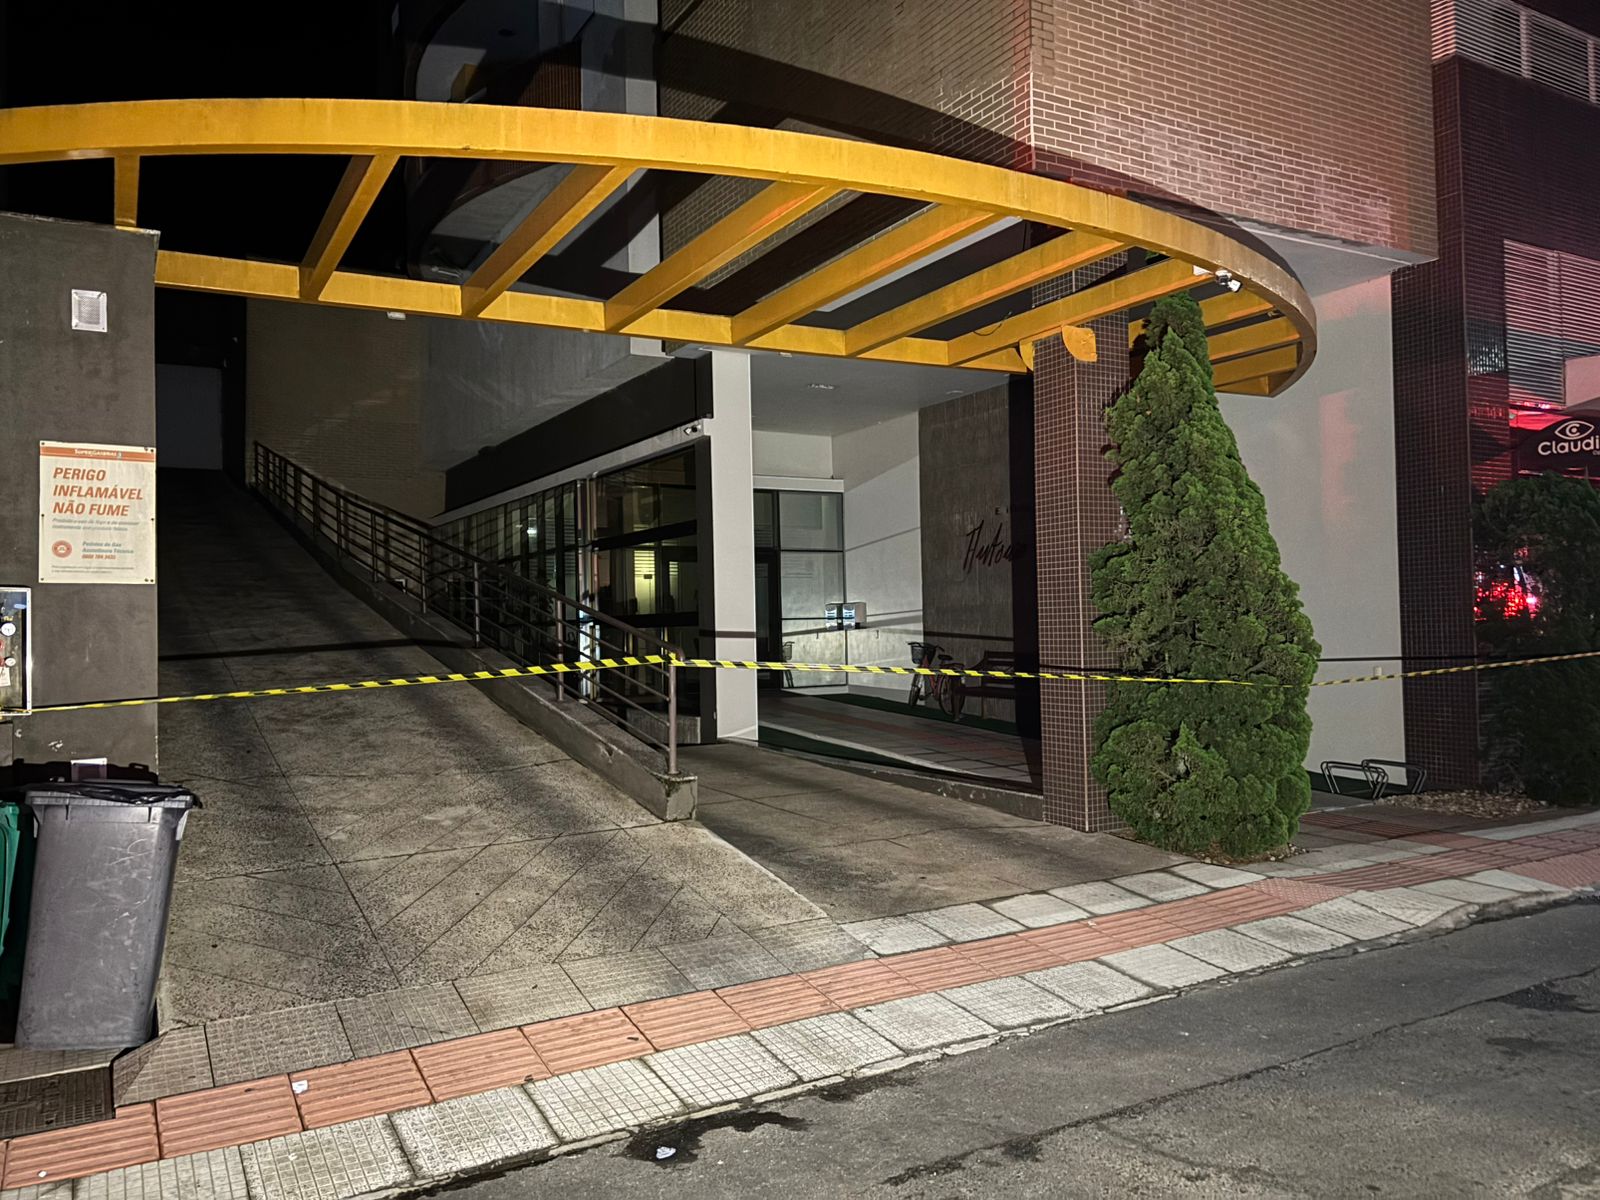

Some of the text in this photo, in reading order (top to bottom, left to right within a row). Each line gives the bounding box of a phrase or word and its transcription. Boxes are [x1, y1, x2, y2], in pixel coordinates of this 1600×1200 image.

[53, 467, 107, 482] PERIGO
[53, 484, 144, 501] INFLAMÁVEL
[53, 500, 130, 517] NÃO FUME
